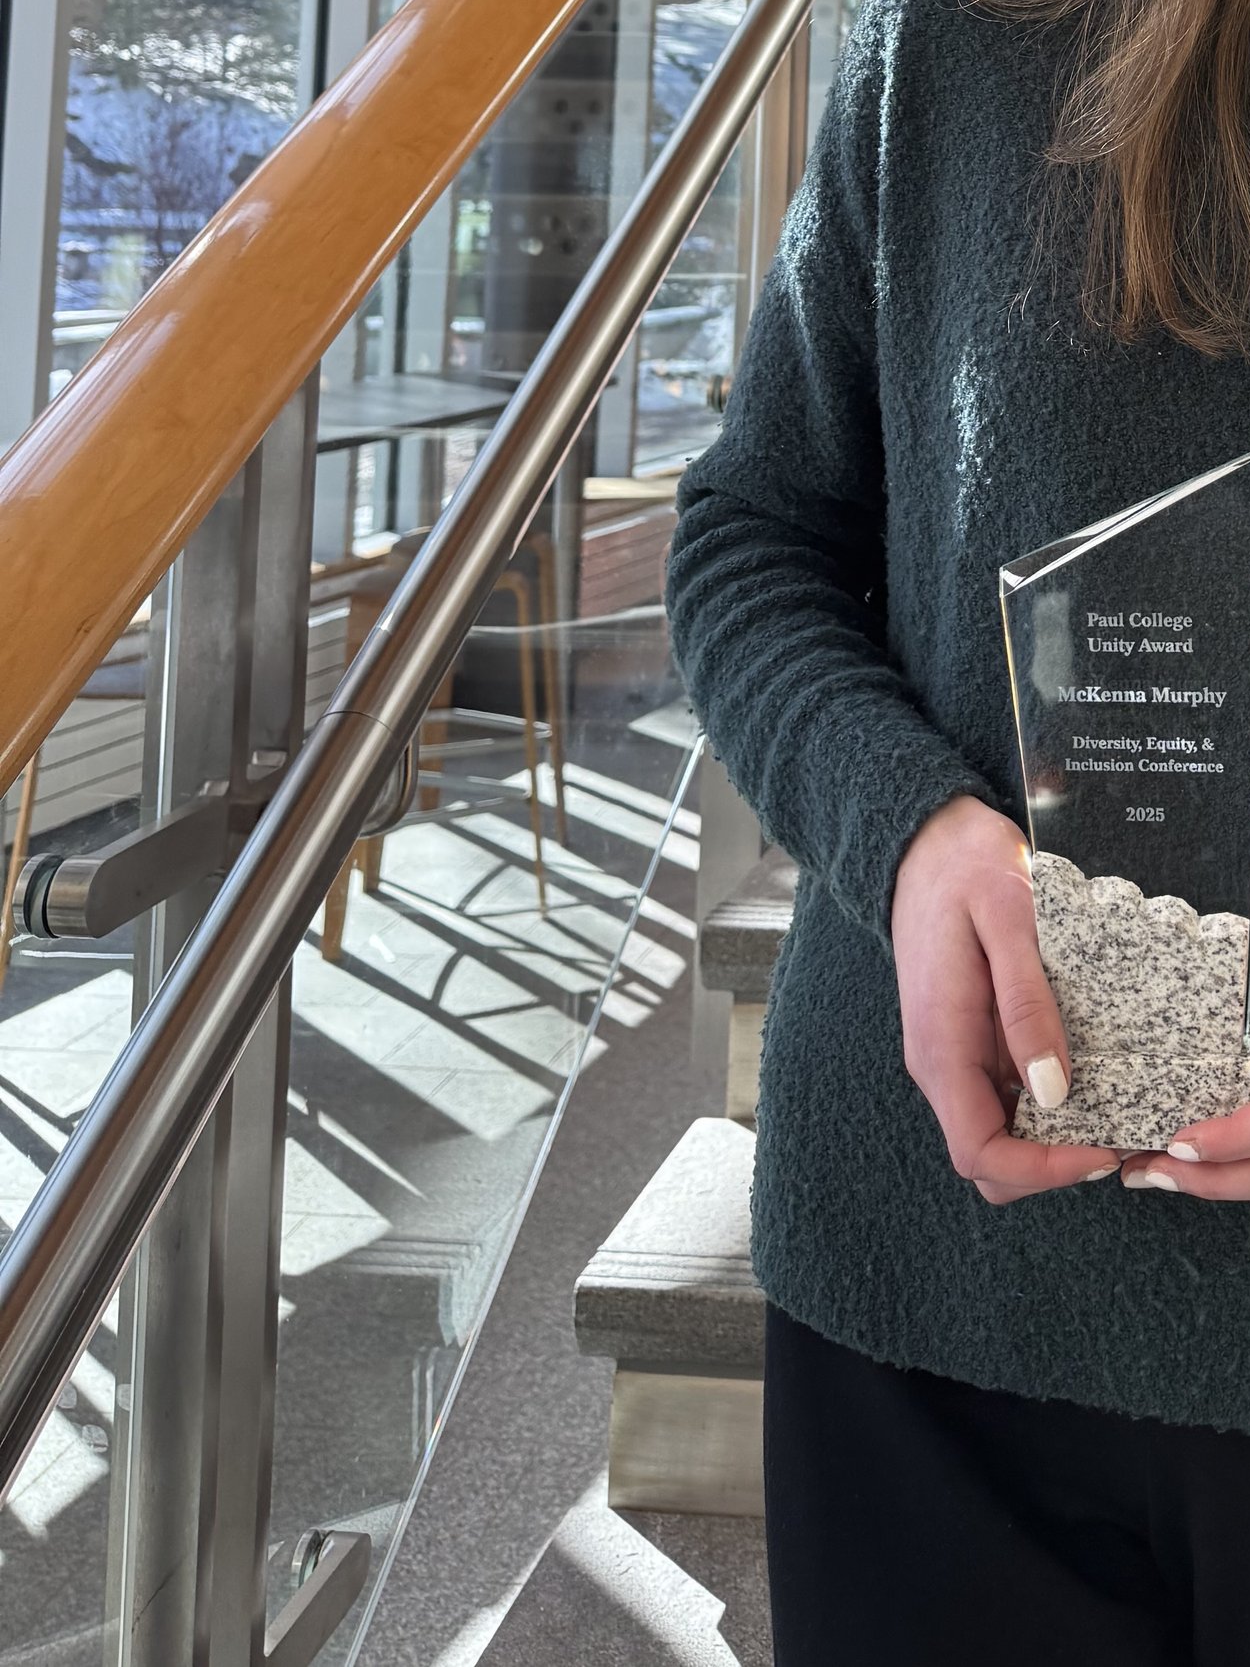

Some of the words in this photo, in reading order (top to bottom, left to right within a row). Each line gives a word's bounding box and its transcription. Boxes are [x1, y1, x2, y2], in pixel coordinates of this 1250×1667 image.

[1087, 613, 1124, 627] Paul
[1129, 613, 1192, 631] College
[1087, 638, 1135, 656] Unity
[1138, 638, 1193, 653] Award
[1058, 687, 1146, 702] McKenna
[1152, 687, 1227, 707] Murphy
[1072, 736, 1142, 751] Diversity,
[1146, 738, 1198, 753] Equity,
[1202, 738, 1214, 750] &
[1065, 758, 1134, 771] Inclusion
[1138, 760, 1224, 773] Conference
[1126, 807, 1165, 822] 2025
